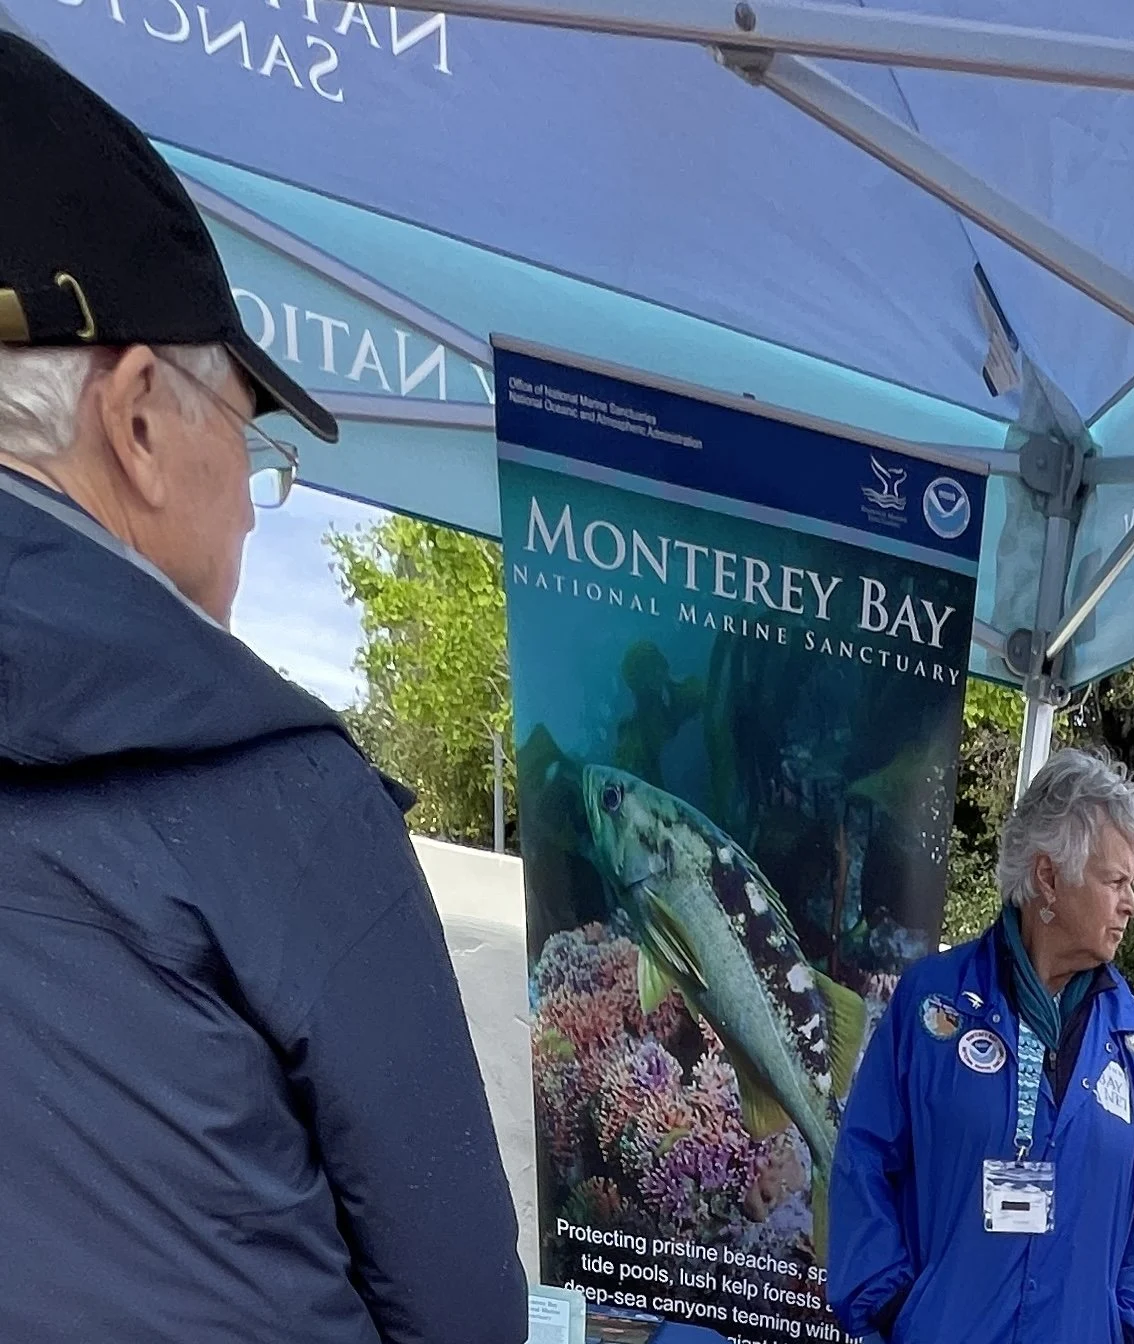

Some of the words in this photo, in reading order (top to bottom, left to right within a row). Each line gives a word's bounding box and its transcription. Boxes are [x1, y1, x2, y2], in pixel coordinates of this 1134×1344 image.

[512, 563, 660, 616] NATIONAL
[678, 602, 787, 645] MARINE
[804, 629, 961, 686] SANCTUARY
[857, 575, 956, 649] BAY
[555, 1217, 646, 1255] Protecting
[652, 1237, 718, 1262] pristine
[723, 1246, 802, 1280] beaches,
[581, 1253, 615, 1275] tide
[619, 1262, 674, 1287] pools,
[679, 1267, 717, 1291] lush
[722, 1274, 758, 1301] kelp
[763, 1282, 821, 1310] forests
[652, 1296, 727, 1320] canyons
[732, 1306, 801, 1338] teeming
[805, 1321, 840, 1343] with
